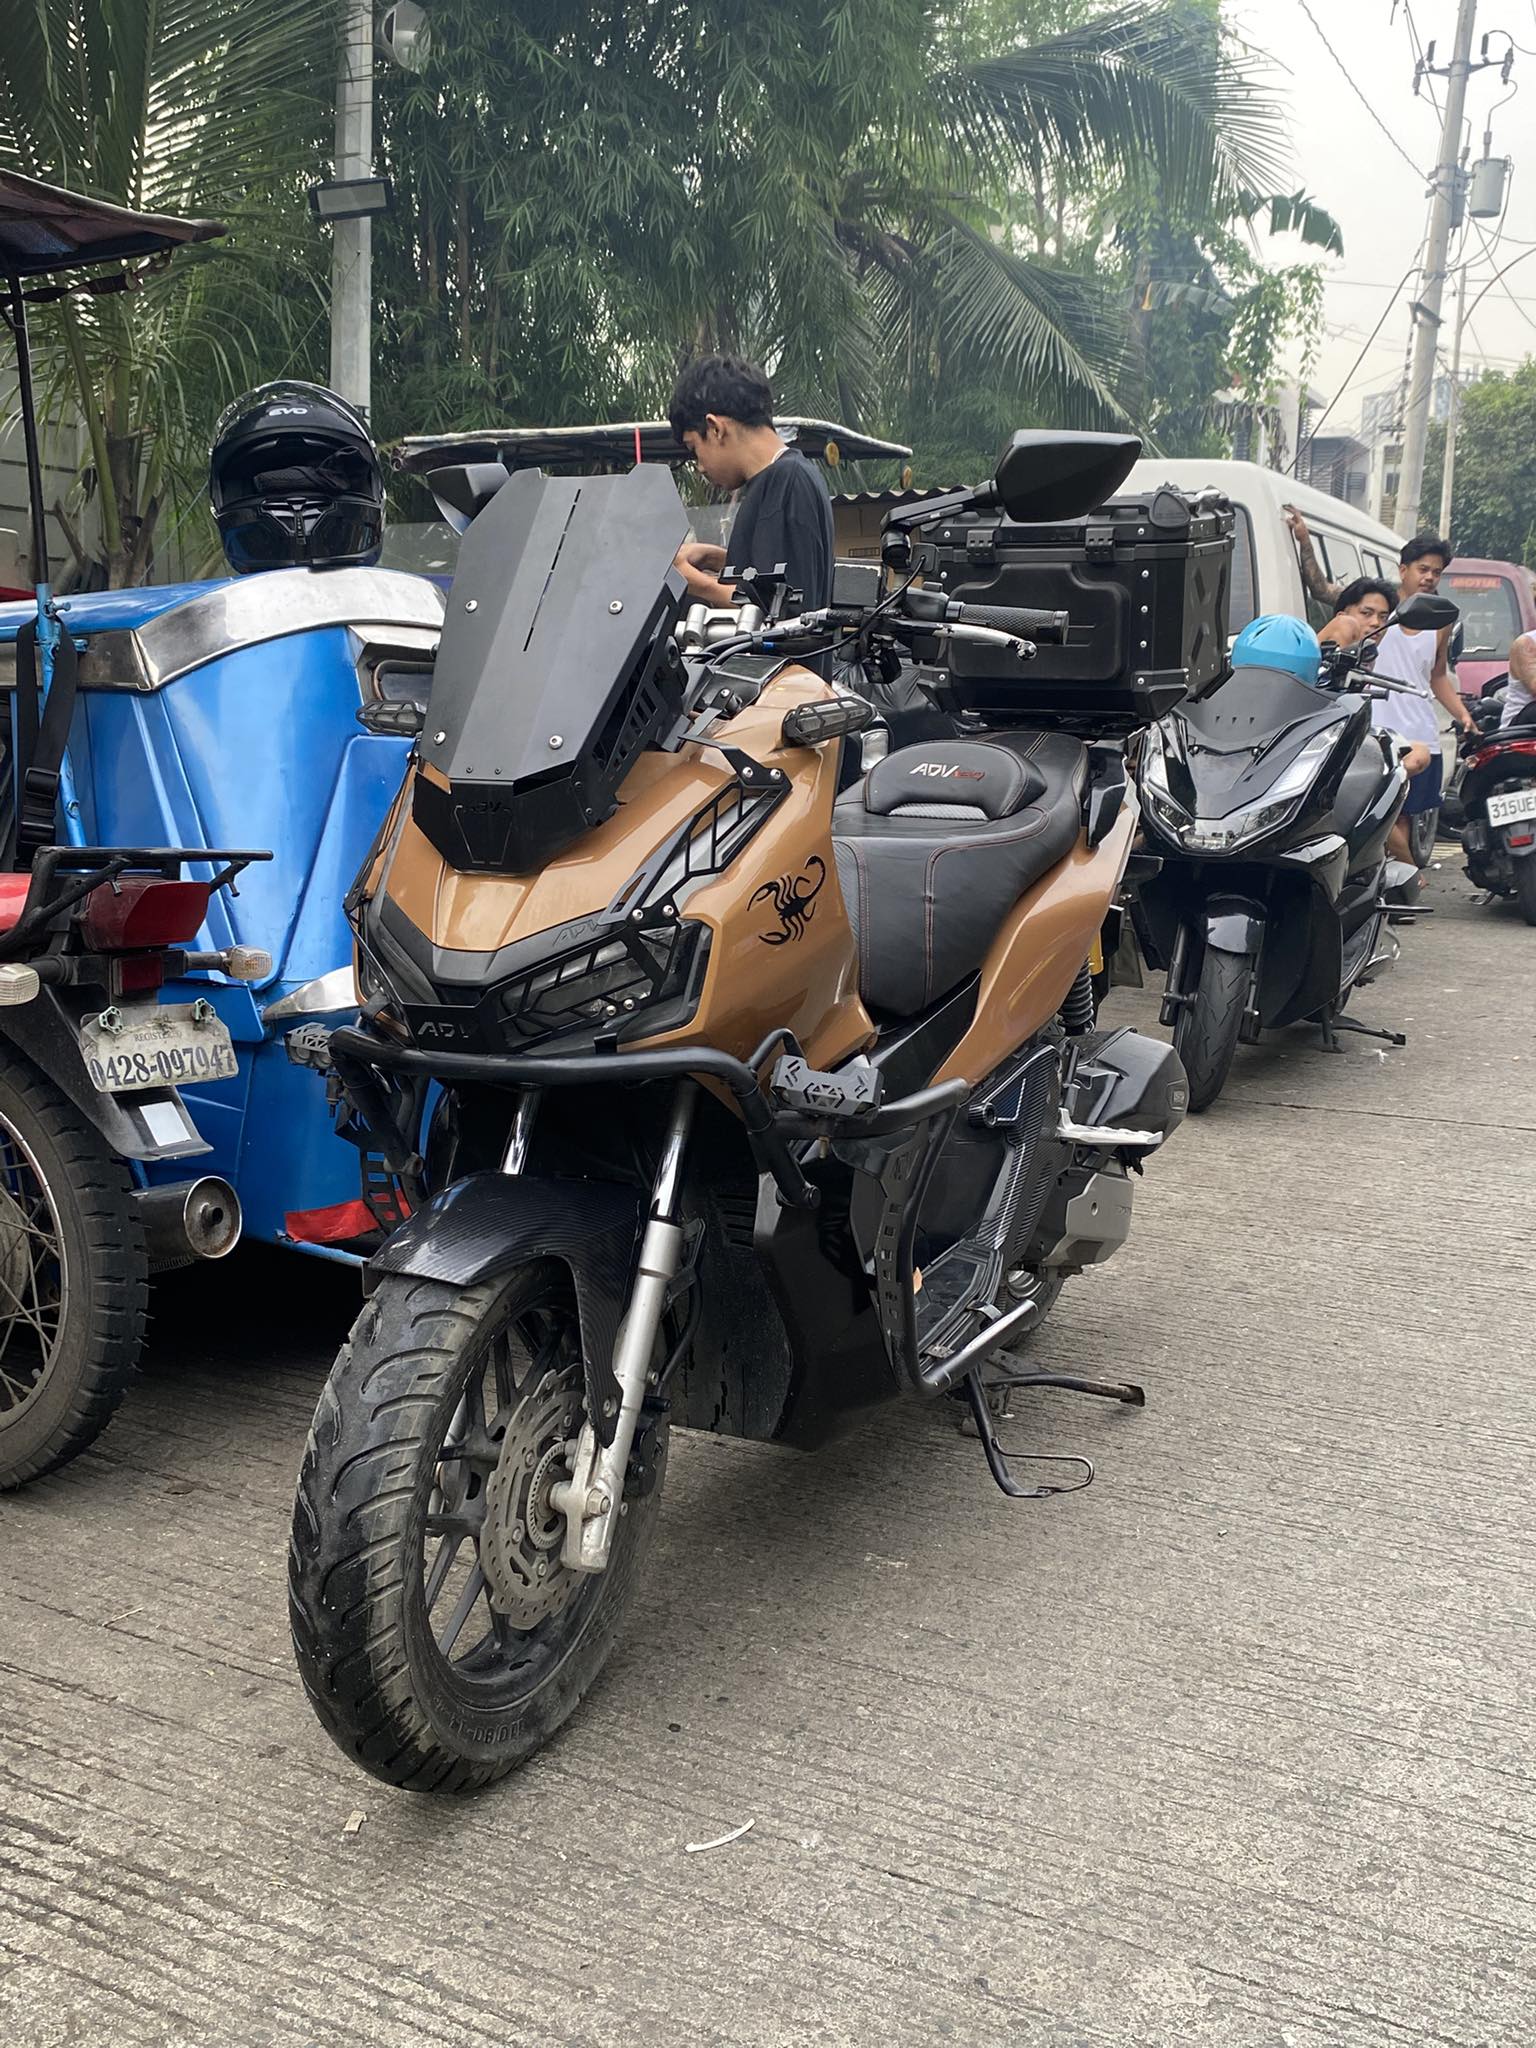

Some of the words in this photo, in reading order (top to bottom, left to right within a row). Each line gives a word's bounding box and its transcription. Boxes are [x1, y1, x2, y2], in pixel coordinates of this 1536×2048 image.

[269, 407, 308, 416] EVO
[1452, 577, 1499, 588] MOTUL
[909, 763, 960, 778] ADV
[1491, 796, 1536, 818] 315UE
